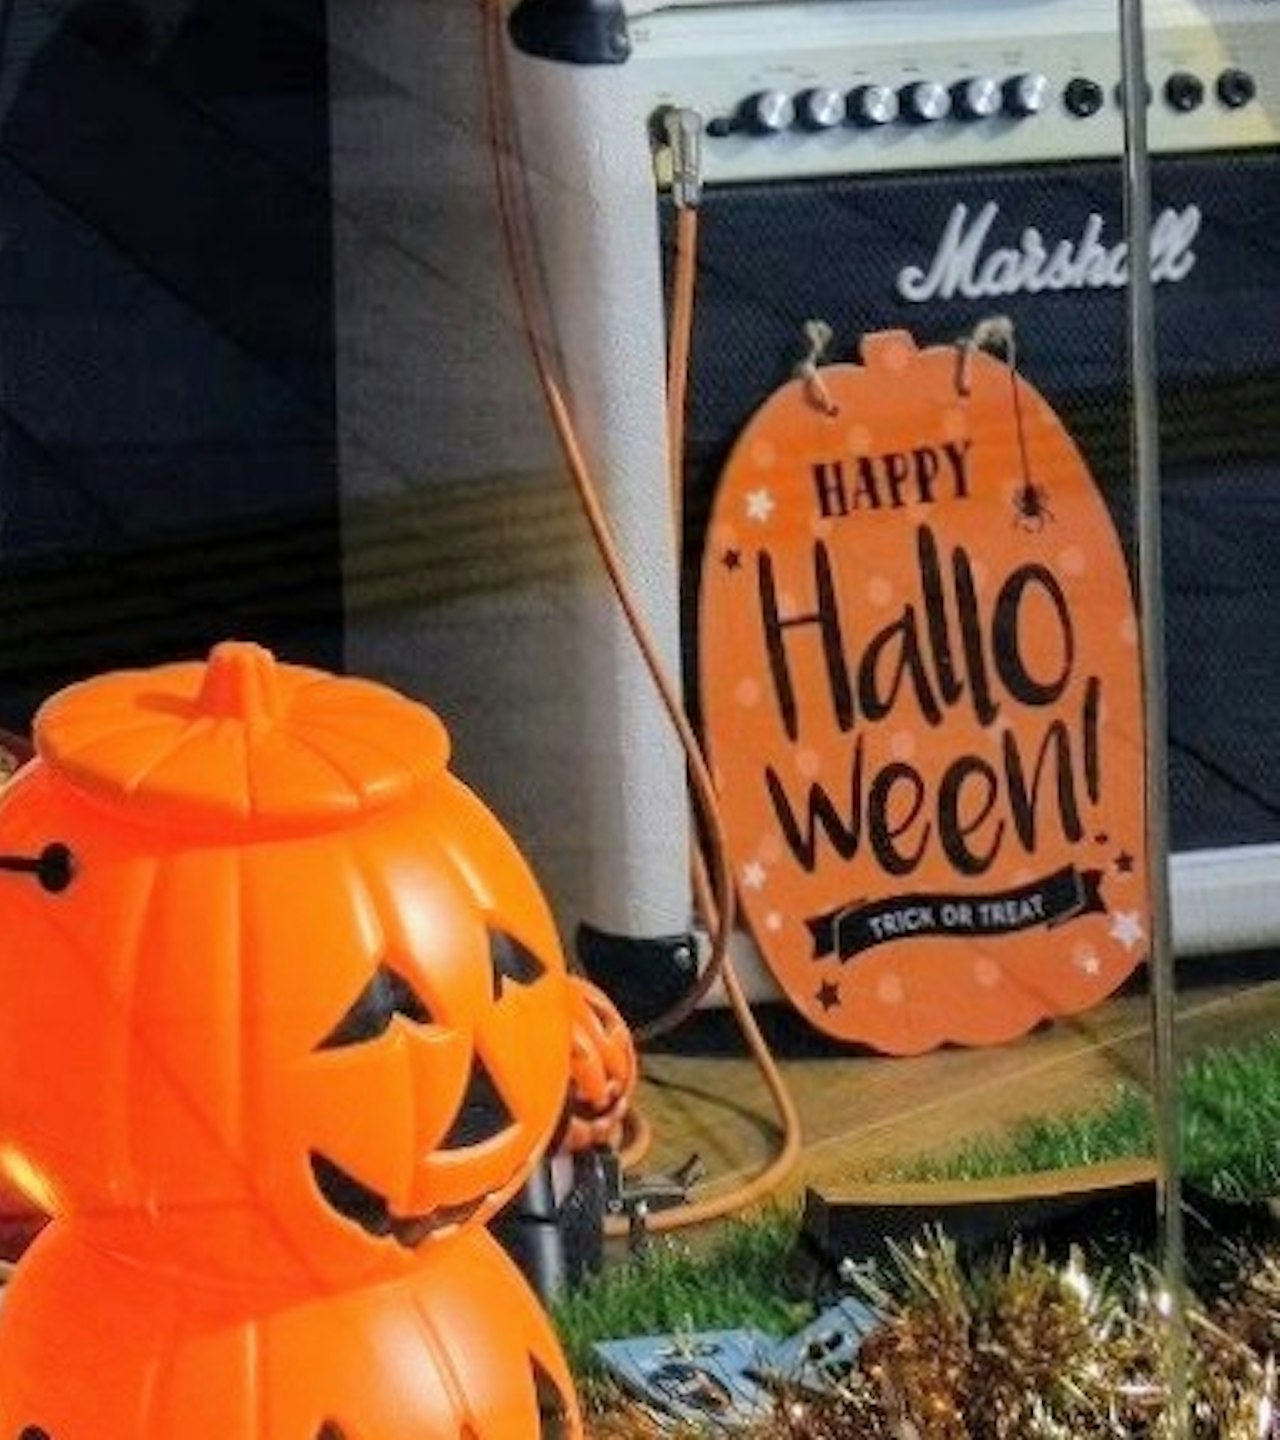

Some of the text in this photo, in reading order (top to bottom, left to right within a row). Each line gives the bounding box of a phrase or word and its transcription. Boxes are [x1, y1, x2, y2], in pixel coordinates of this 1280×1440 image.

[896, 200, 1202, 302] Marshall
[811, 440, 974, 518] HAPPY
[868, 892, 1046, 941] TRICK OR TREAT
